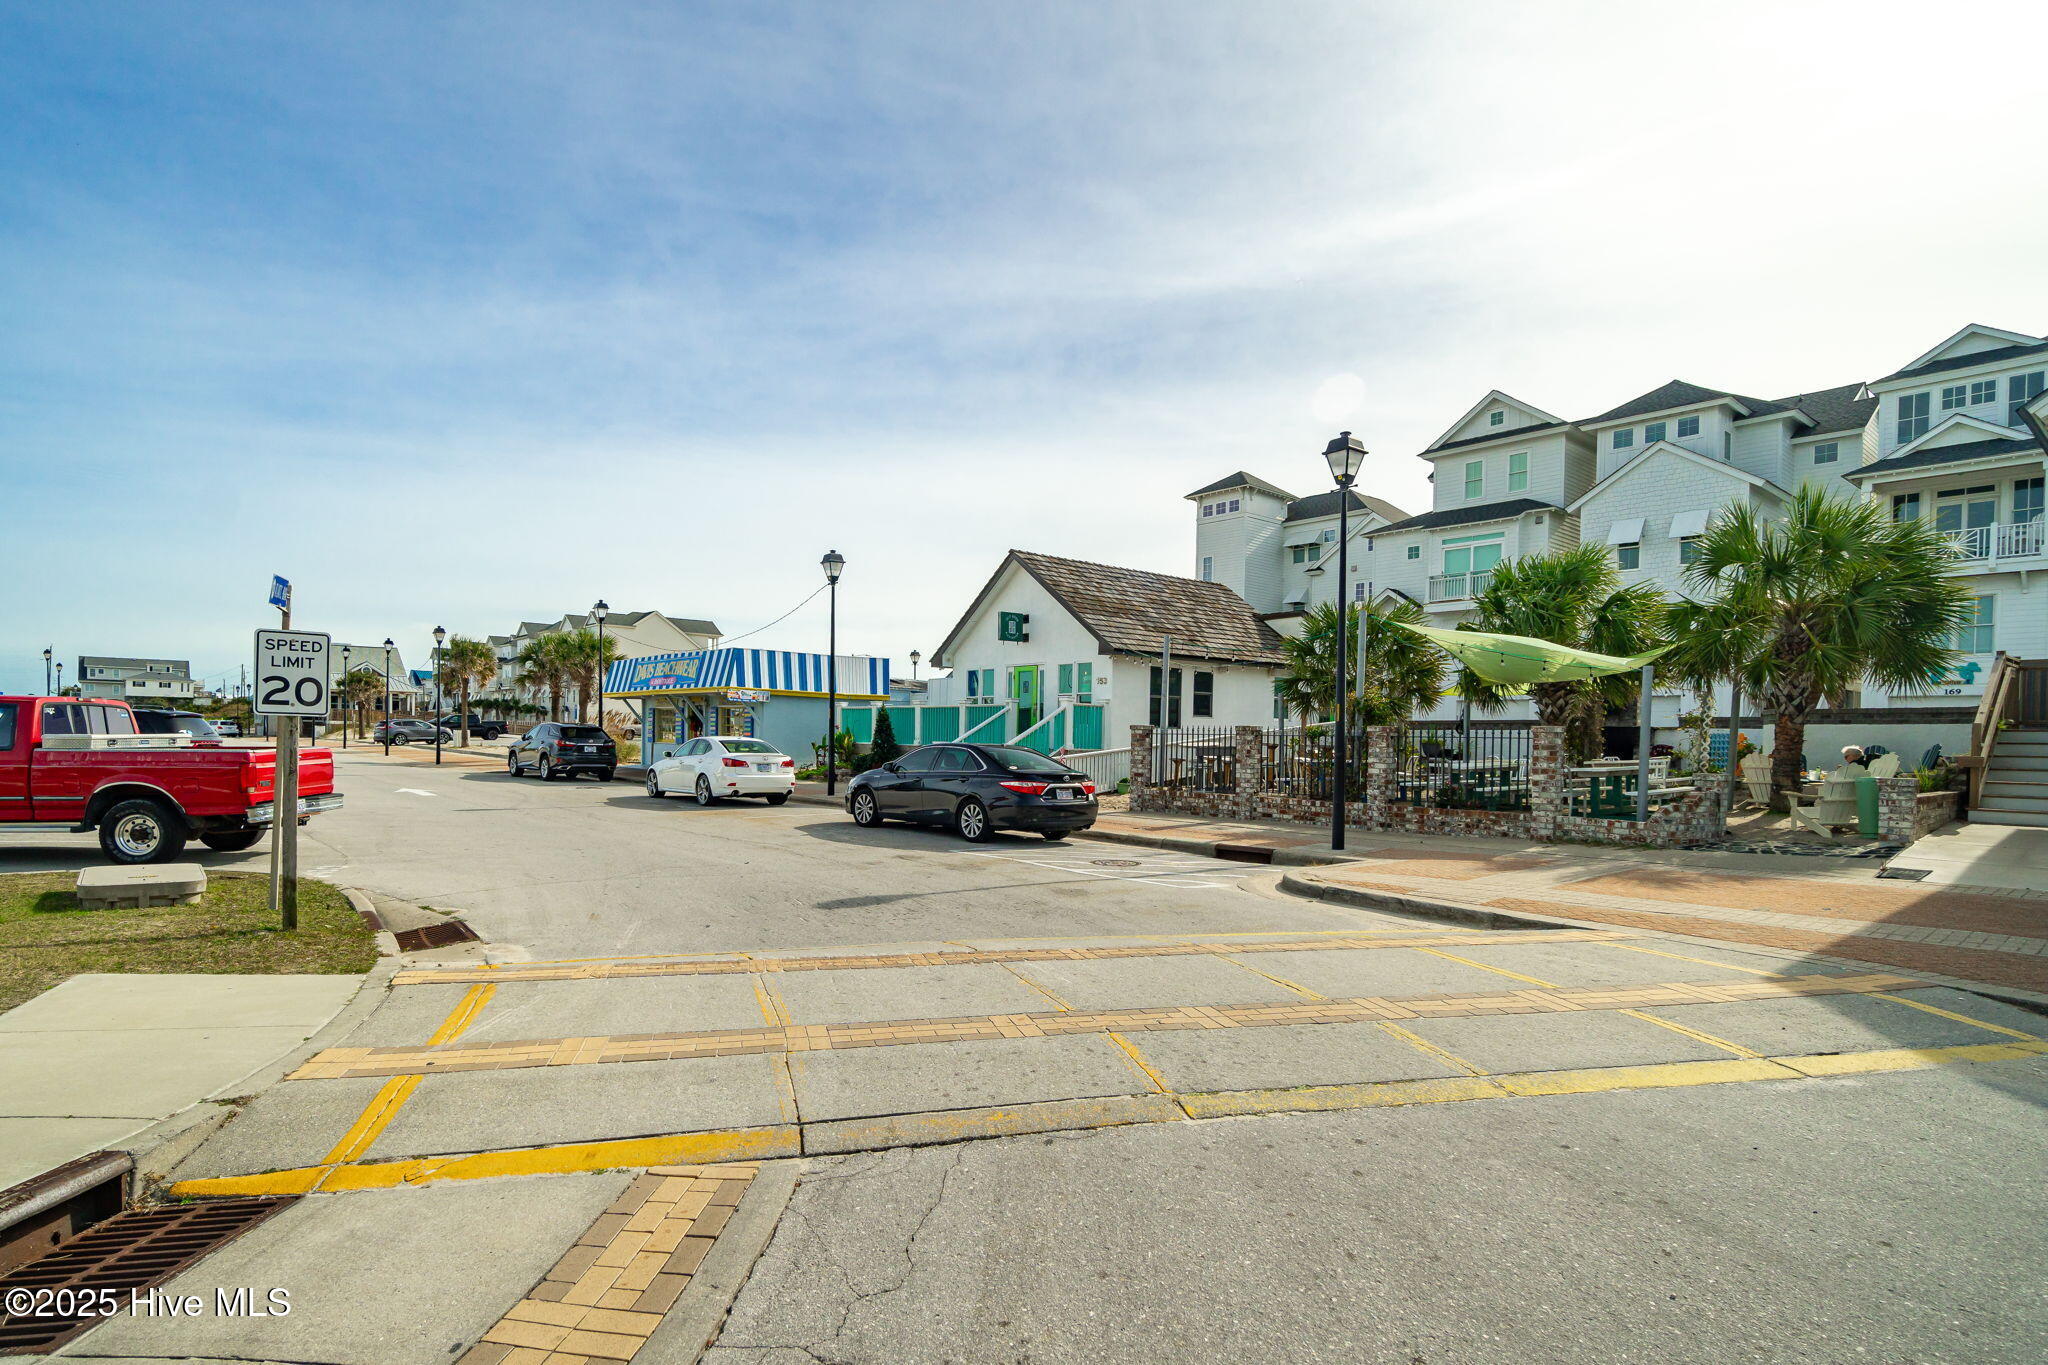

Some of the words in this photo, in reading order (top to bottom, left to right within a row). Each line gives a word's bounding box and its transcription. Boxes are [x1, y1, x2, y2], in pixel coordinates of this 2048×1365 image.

[265, 638, 323, 653] SPEED
[271, 655, 315, 669] LIMIT
[652, 659, 699, 679] BEACHWEAR
[261, 675, 324, 707] 20
